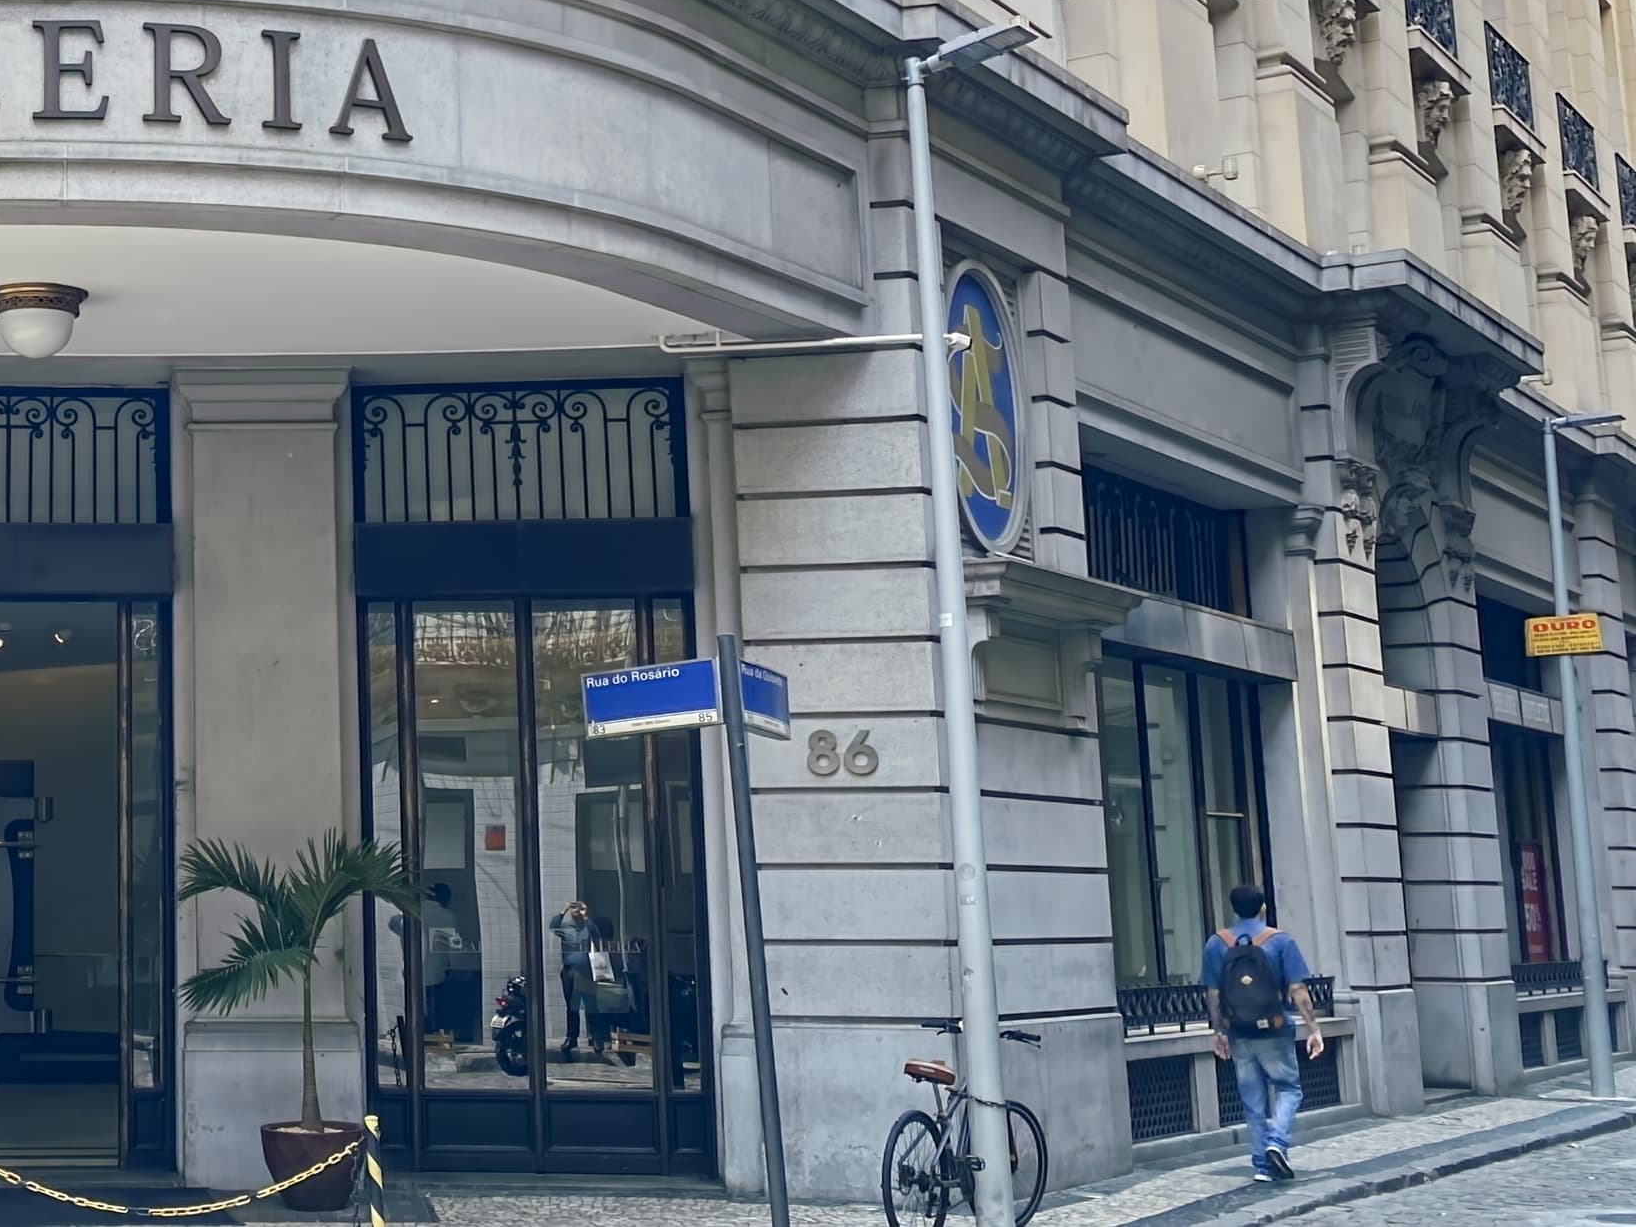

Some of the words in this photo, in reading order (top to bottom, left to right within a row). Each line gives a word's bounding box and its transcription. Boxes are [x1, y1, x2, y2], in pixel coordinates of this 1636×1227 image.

[1532, 619, 1597, 633] OURO
[586, 677, 610, 689] Rua
[612, 674, 628, 685] do
[631, 667, 680, 682] Rosário
[698, 712, 713, 723] 85
[807, 729, 880, 777] 86
